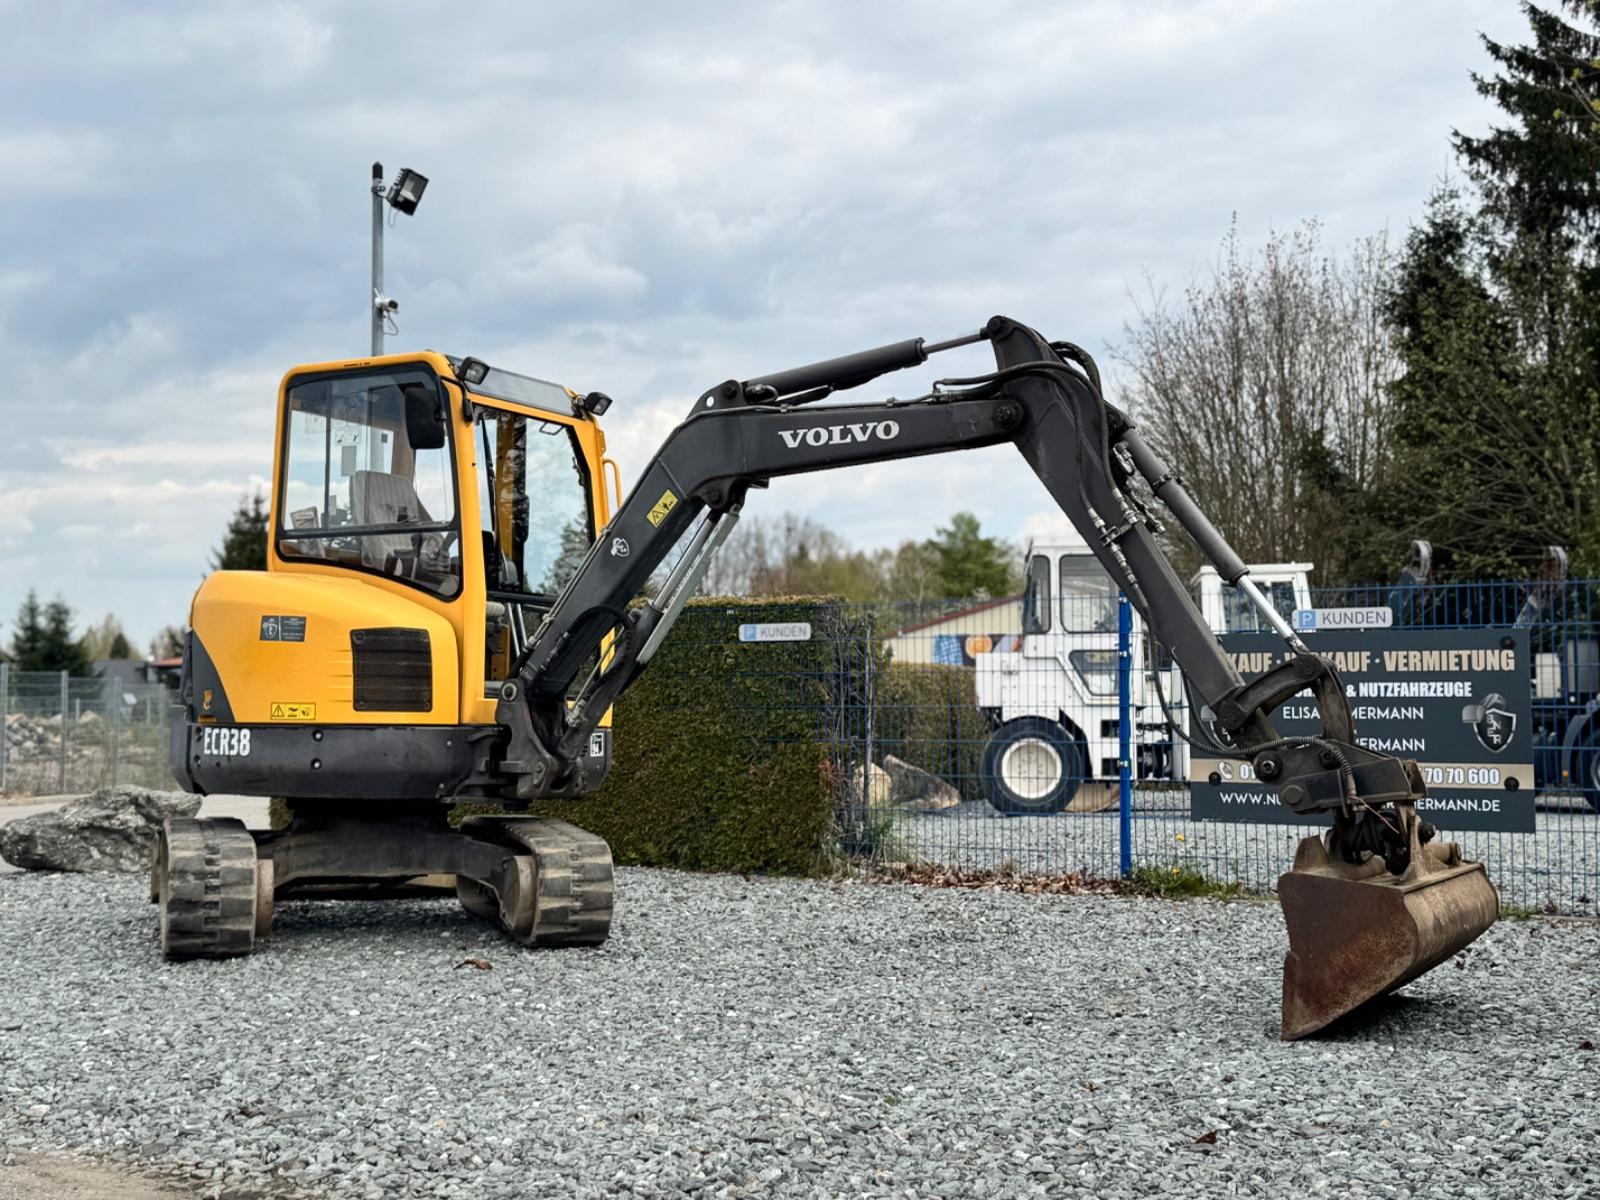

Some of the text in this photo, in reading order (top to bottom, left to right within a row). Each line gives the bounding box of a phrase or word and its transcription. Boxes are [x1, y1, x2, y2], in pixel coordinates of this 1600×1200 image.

[778, 420, 899, 448] VOLVO
[1322, 611, 1386, 625] KUNDEN
[760, 626, 806, 638] KUNDEN
[1226, 652, 1273, 673] KAUF
[1383, 650, 1515, 672] VERMIETUNG
[1345, 682, 1473, 698] & NUTZFAHRZEUGE
[1283, 706, 1321, 719] ELISA
[203, 727, 251, 757] ECR38
[1356, 738, 1426, 752] ERMANN
[1424, 767, 1443, 785] 70
[1446, 767, 1464, 785] 70
[1468, 767, 1500, 785] 600
